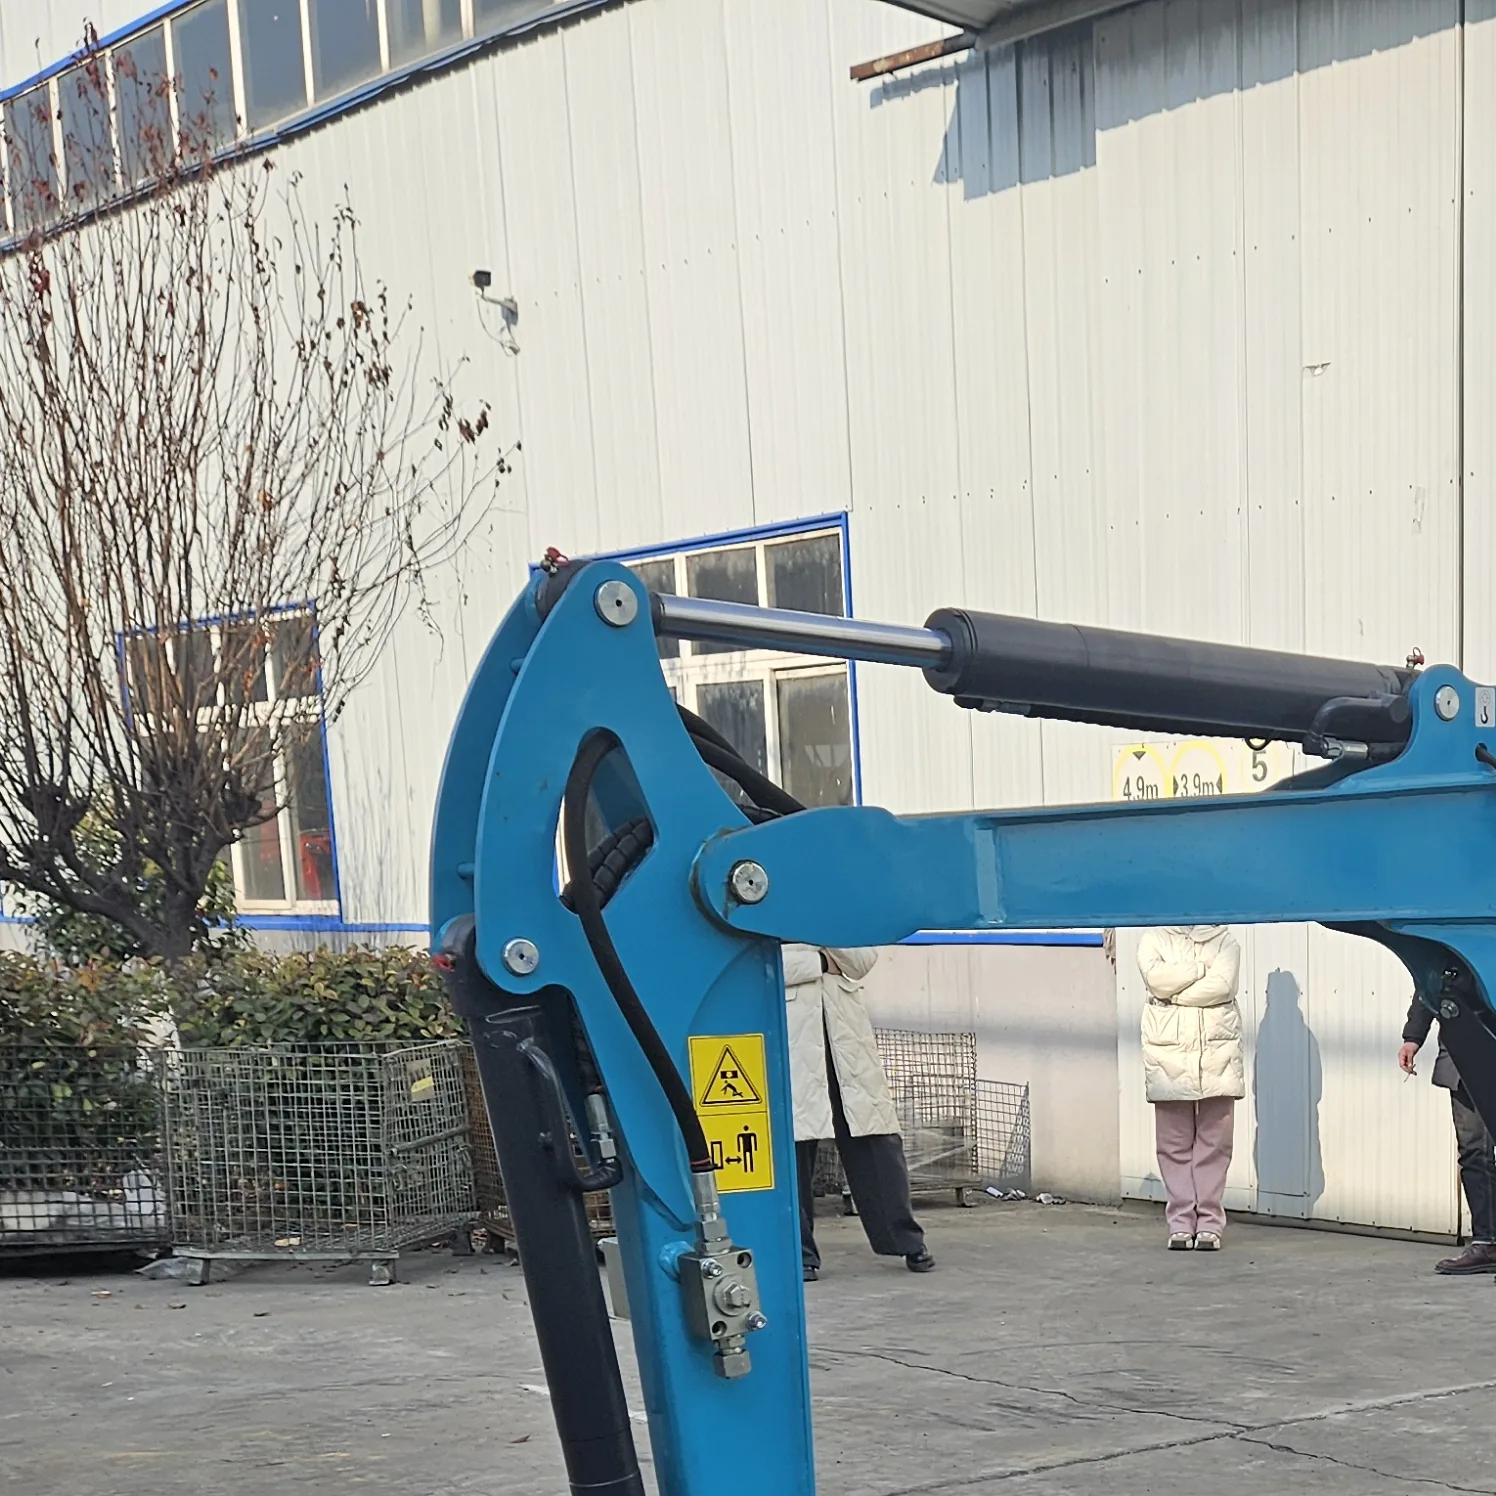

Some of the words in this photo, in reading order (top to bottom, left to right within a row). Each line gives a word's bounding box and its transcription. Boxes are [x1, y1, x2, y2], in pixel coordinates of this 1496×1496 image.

[1251, 750, 1268, 782] 5
[1123, 775, 1159, 800] 4.9m
[1180, 773, 1214, 797] 3.9m
